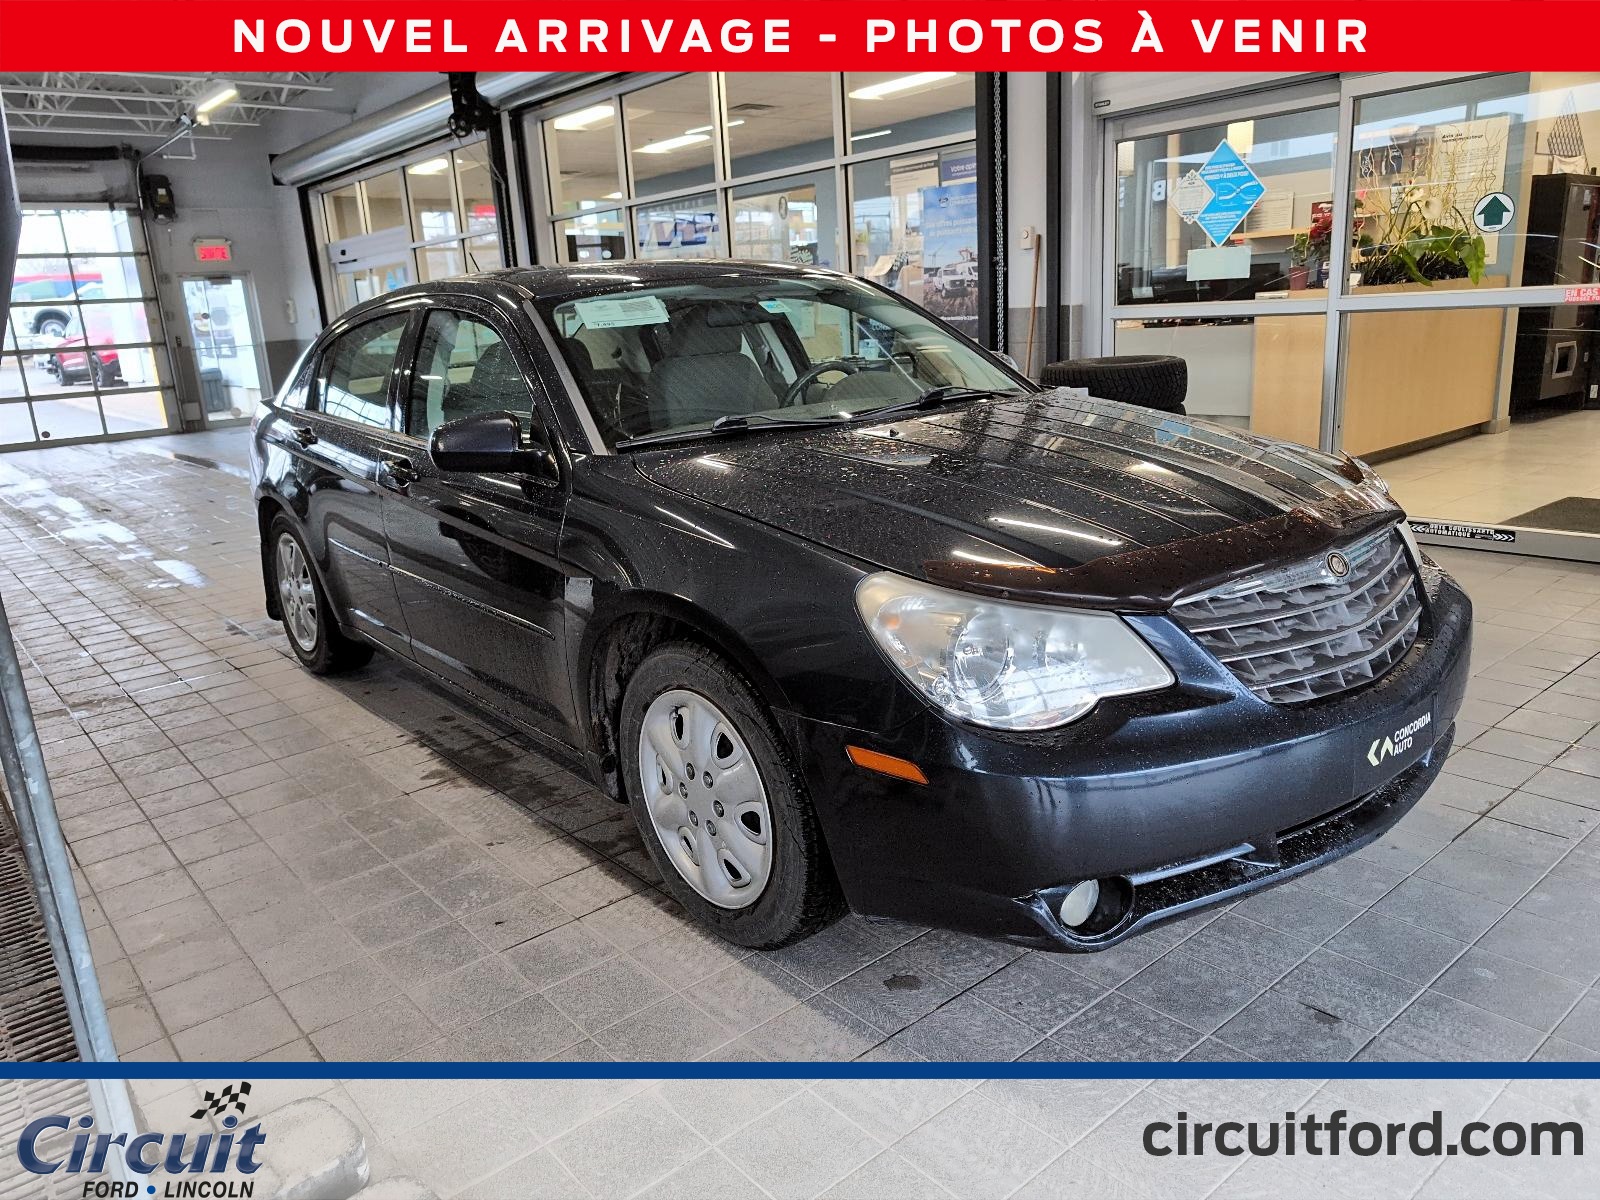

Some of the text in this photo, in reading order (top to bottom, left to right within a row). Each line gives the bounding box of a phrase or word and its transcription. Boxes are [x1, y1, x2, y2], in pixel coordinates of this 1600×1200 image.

[1580, 287, 1599, 296] CAS
[1425, 528, 1471, 538] AUTOMATIQUE
[1394, 711, 1431, 743] CONCORDIA
[1393, 736, 1413, 757] AUTO
